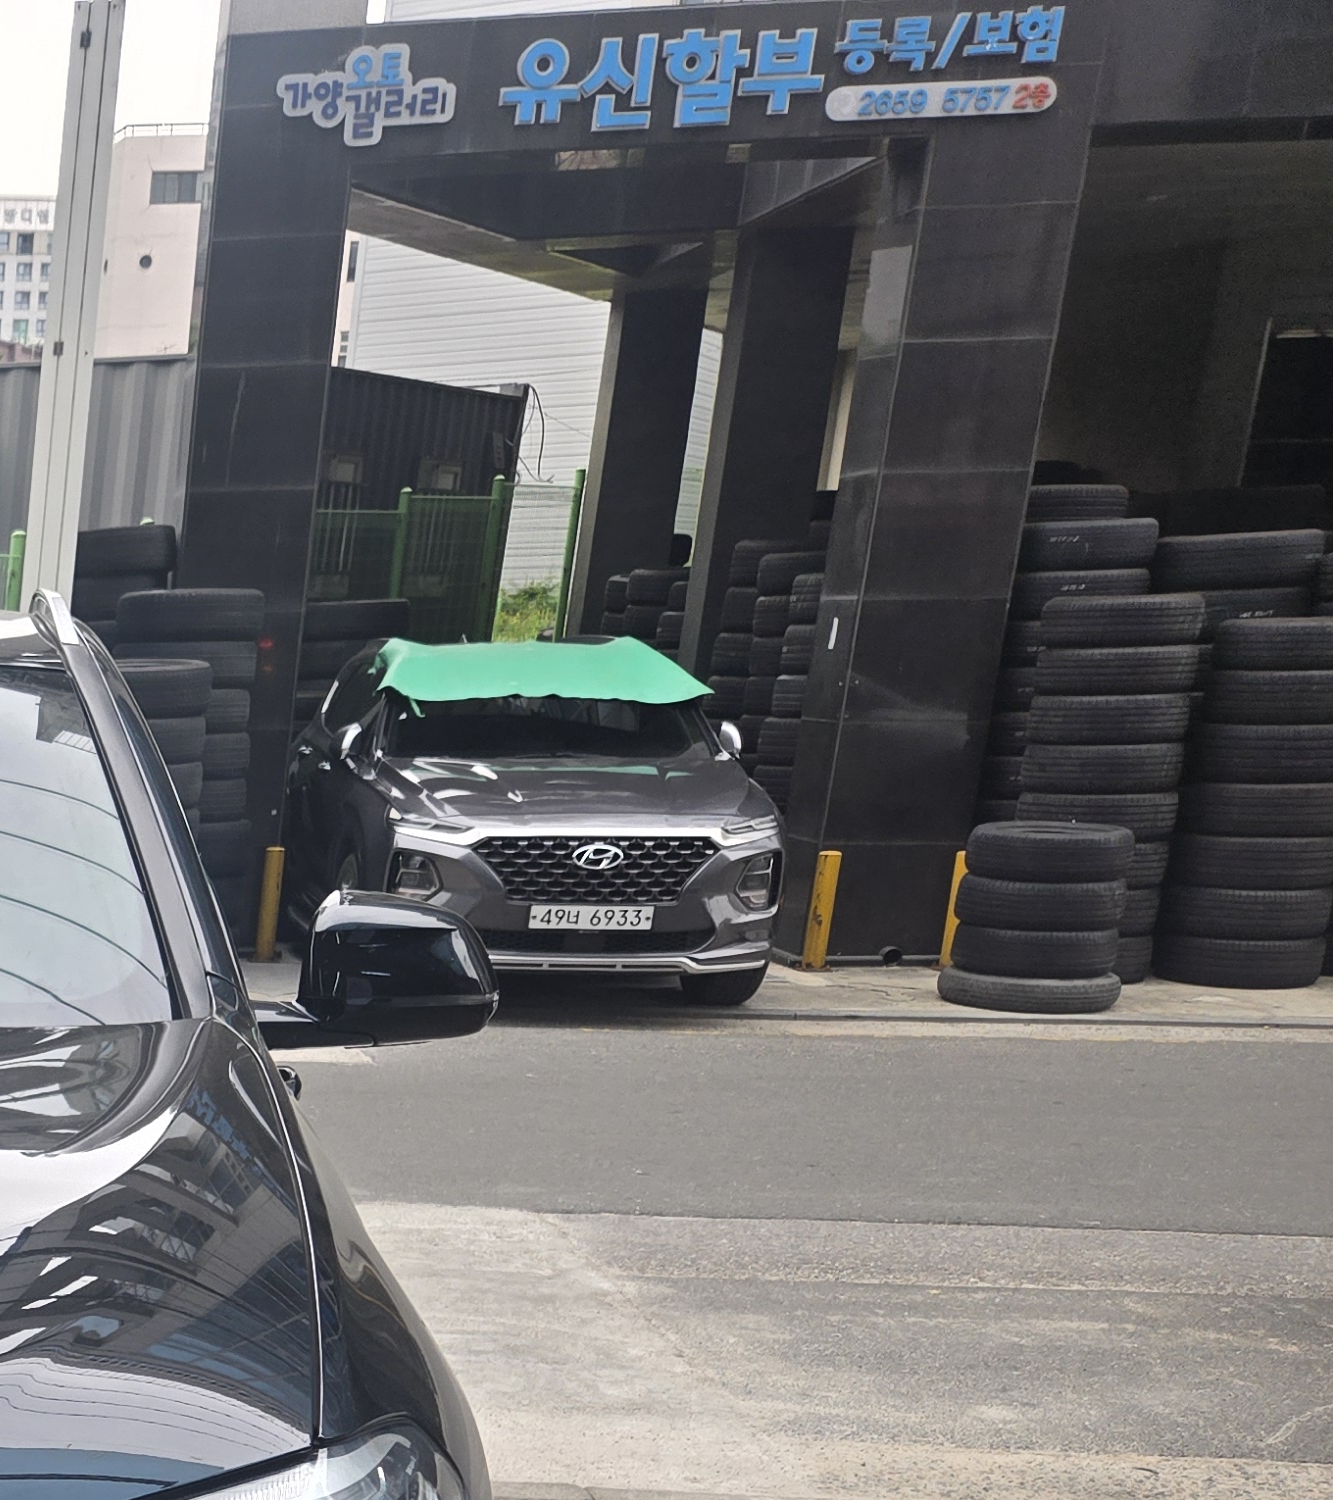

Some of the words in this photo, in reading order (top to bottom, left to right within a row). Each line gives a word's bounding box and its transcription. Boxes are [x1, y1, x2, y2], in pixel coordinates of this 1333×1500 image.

[834, 6, 1065, 75] 등록/보험
[347, 52, 404, 90] 오토
[498, 28, 825, 132] 유신할부
[285, 79, 344, 120] 가양
[345, 86, 447, 139] 갤러리
[857, 89, 928, 116] 2659
[942, 85, 1010, 113] 5757
[1012, 82, 1051, 109] 2층
[539, 908, 580, 926] 49너
[589, 909, 643, 927] 6933
